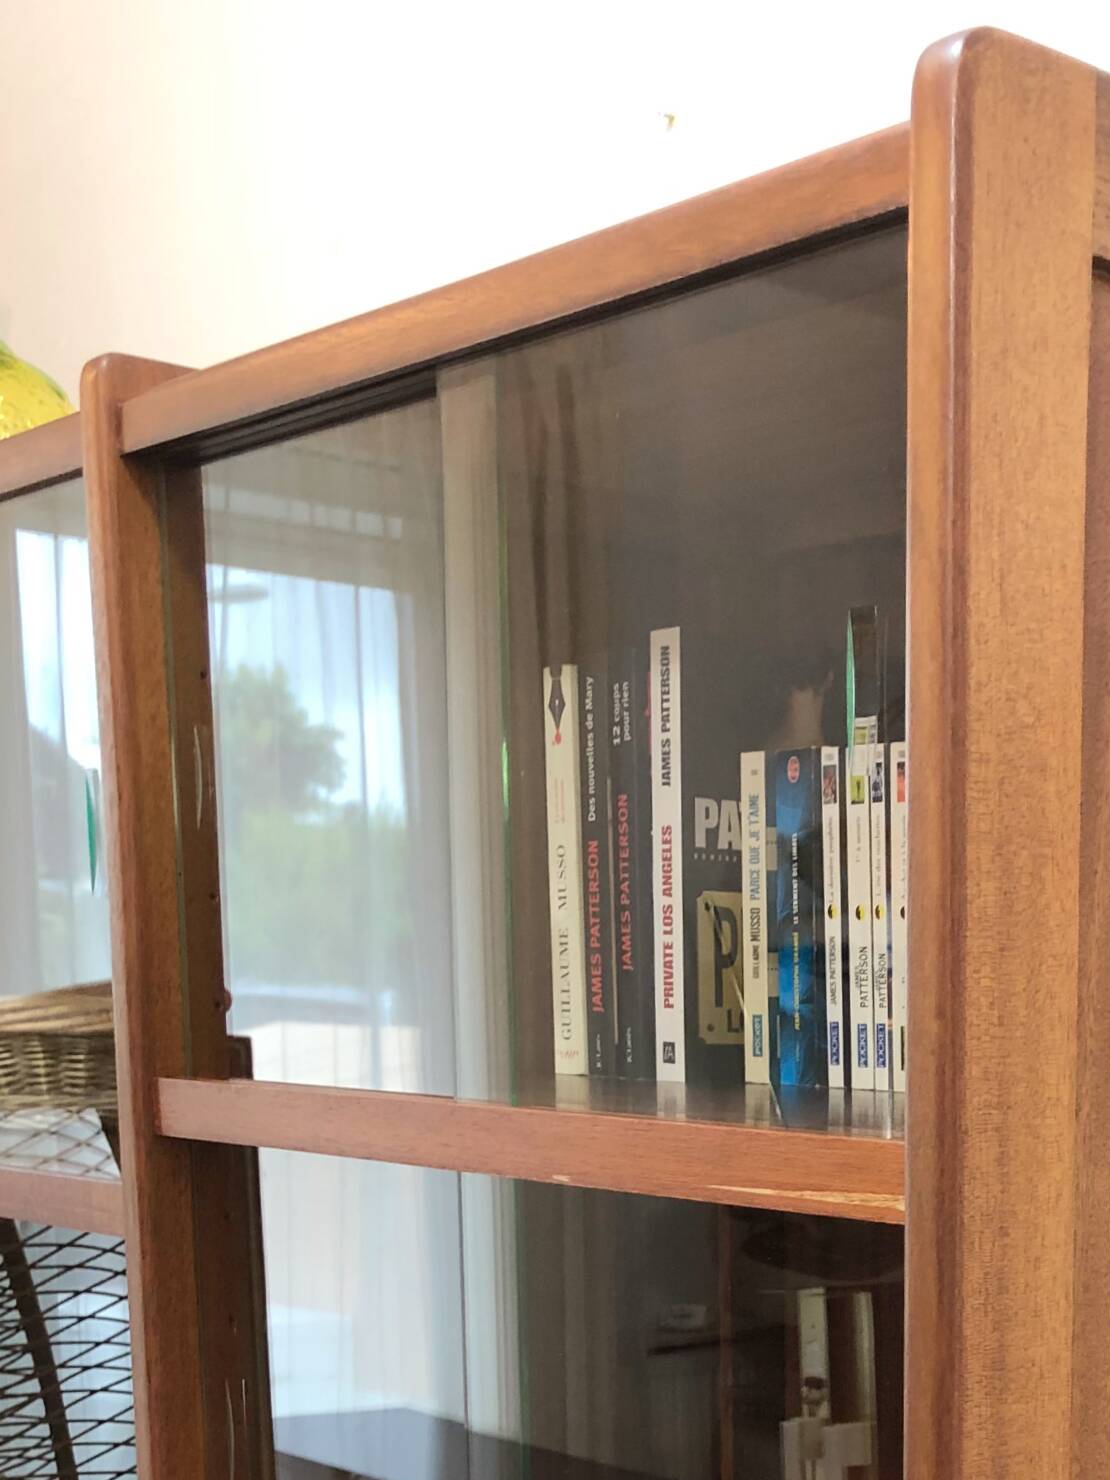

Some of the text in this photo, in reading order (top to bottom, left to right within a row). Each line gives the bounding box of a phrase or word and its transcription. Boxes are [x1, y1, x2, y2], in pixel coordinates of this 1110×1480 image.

[612, 683, 622, 745] 12 coups
[621, 681, 631, 741] pour rien
[659, 645, 672, 787] JAMES PATTERSON
[584, 676, 597, 822] Des nouvelles de Mary
[694, 796, 742, 851] PA
[557, 844, 568, 910] MUSSO
[617, 794, 634, 971] JAMES PATTERSON
[749, 868, 761, 900] PARCE
[587, 840, 605, 1014] JAMES PATTERSON
[661, 825, 675, 1010] PRIVATE LOS ANGELES
[750, 908, 761, 942] MUSSO
[560, 928, 572, 1041] GUILLAUME
[828, 936, 836, 981] PATTERSON
[859, 945, 868, 1008] PATTERSON
[878, 952, 887, 1009] PATTERSON
[726, 1009, 744, 1033] L
[830, 1023, 839, 1064] POCKET
[858, 1024, 868, 1067] POCKET
[877, 1024, 887, 1067] POCKET
